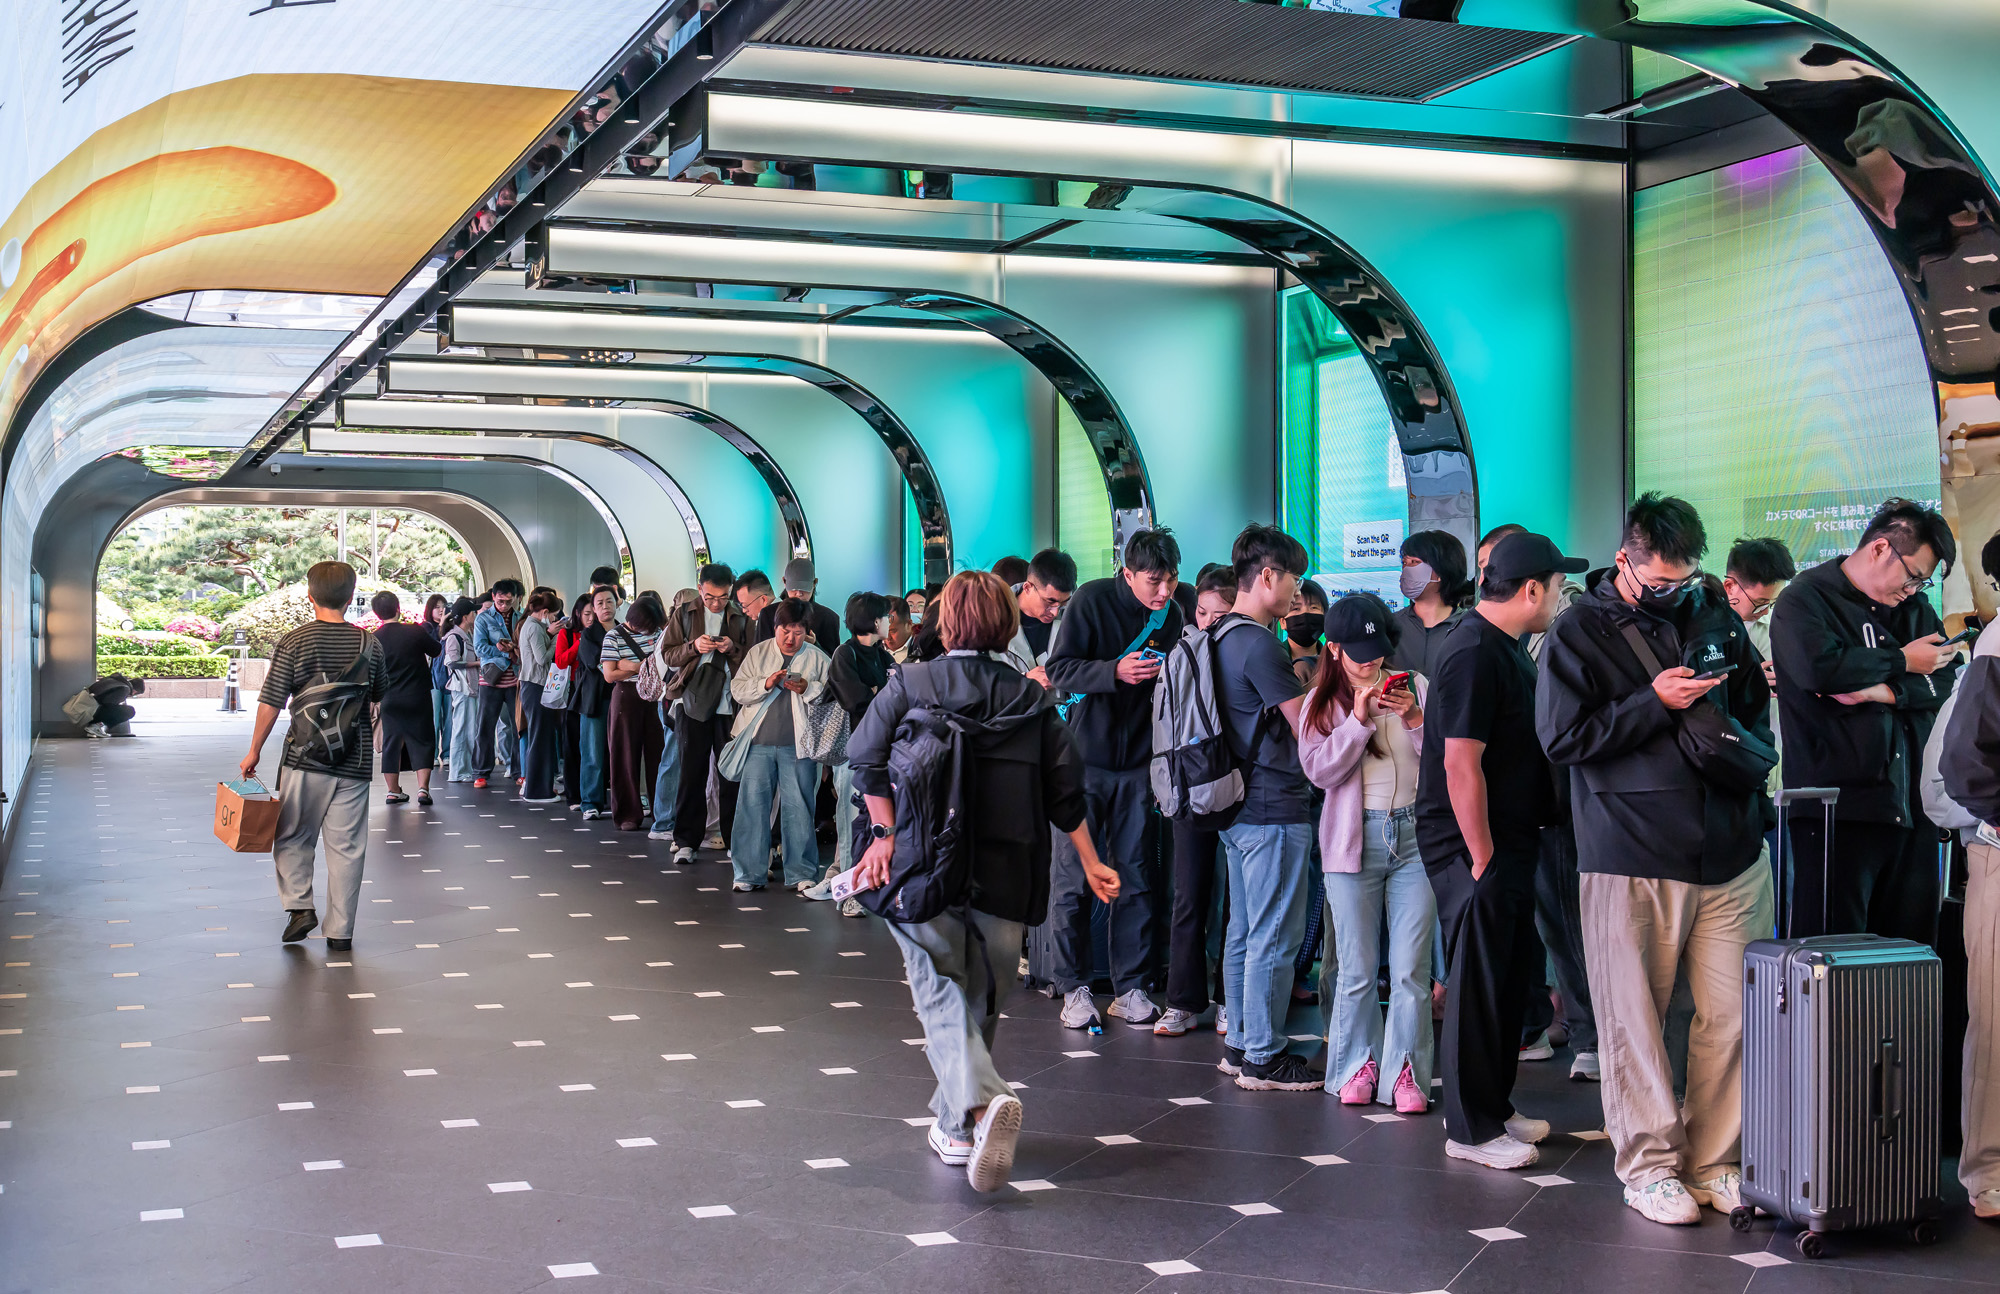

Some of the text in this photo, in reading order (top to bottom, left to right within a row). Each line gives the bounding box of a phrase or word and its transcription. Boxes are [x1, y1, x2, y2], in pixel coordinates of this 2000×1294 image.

[1765, 506, 1839, 521] カメラでQRコードを
[1813, 518, 1870, 532] すぐに体験でき
[1356, 534, 1390, 544] Scan the QR
[1350, 547, 1396, 558] to start the game
[1819, 548, 1837, 557] STAR
[1703, 652, 1725, 662] CAMEL
[221, 804, 236, 826] gr
